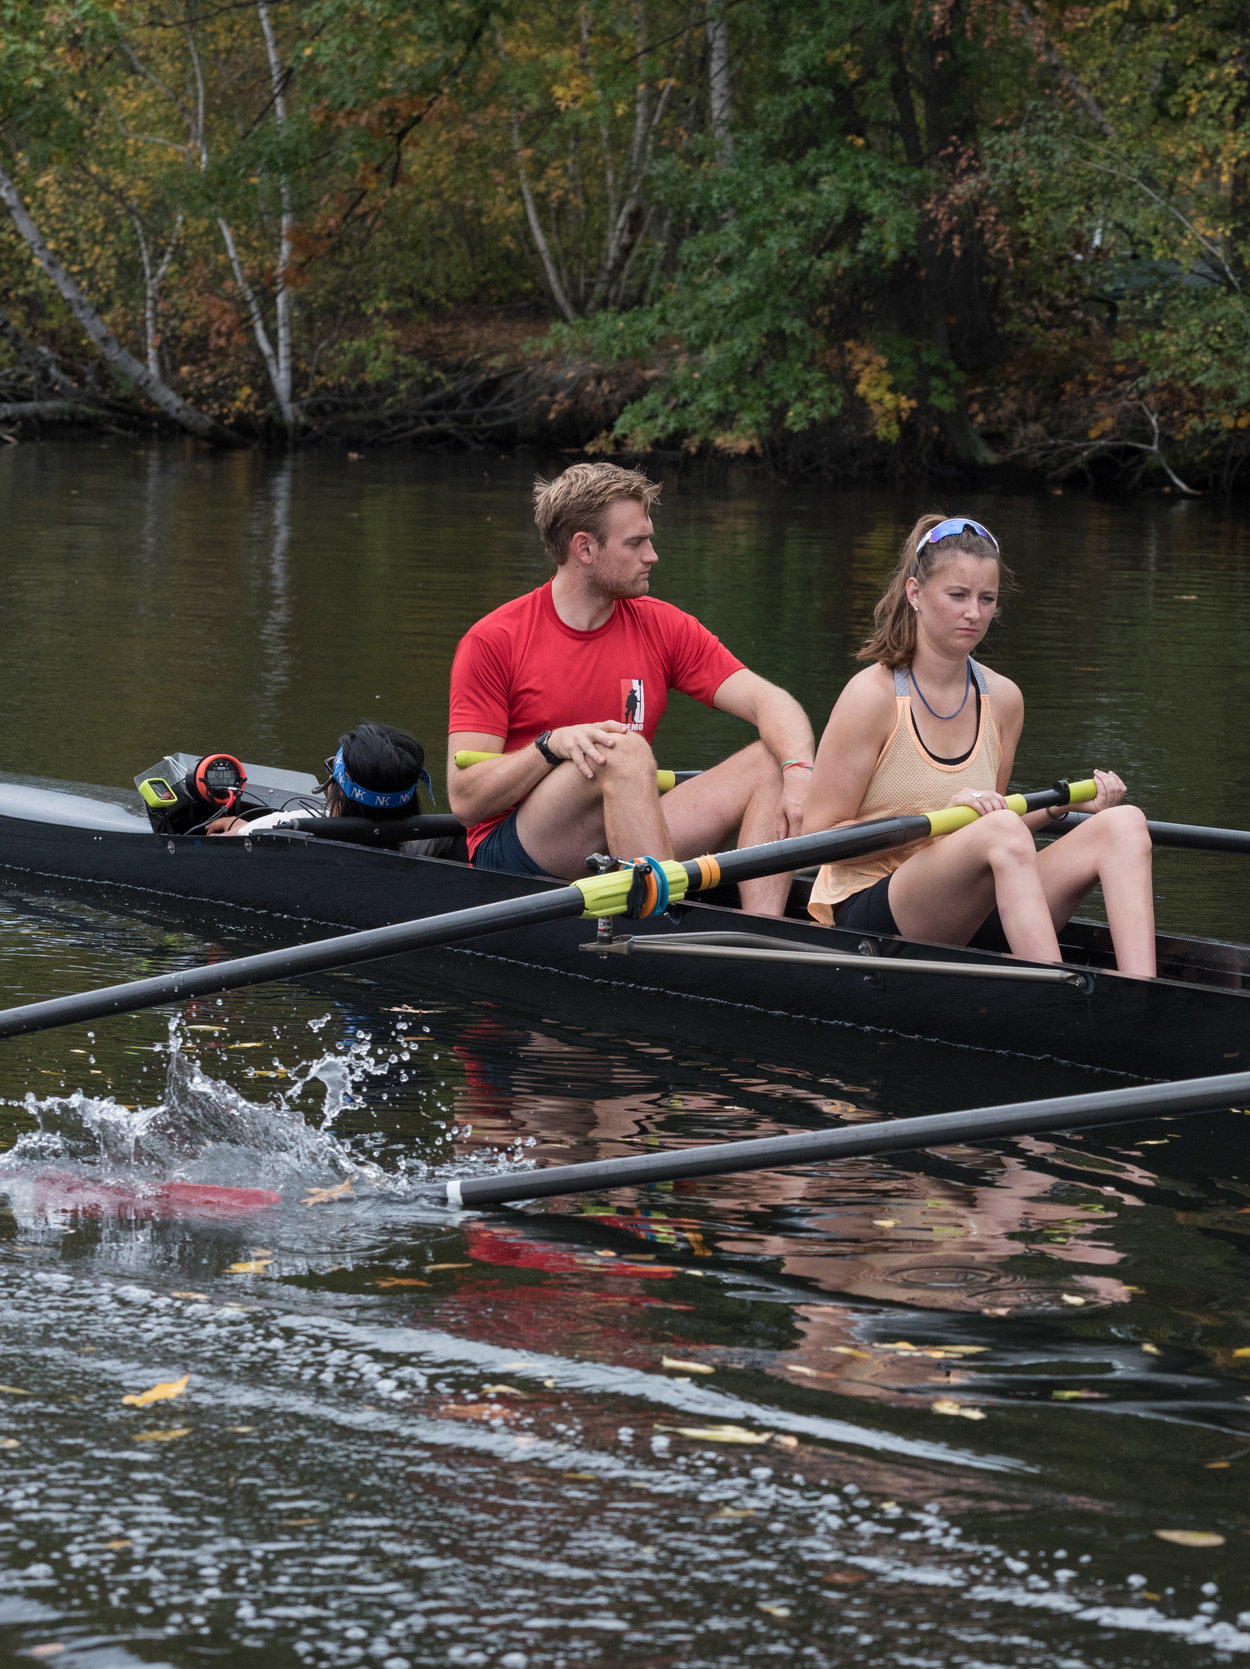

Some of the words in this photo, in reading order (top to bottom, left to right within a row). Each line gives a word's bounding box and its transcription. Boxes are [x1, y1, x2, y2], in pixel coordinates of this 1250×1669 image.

[350, 787, 366, 801] NK
[374, 796, 391, 806] NK
[398, 791, 410, 804] NK
